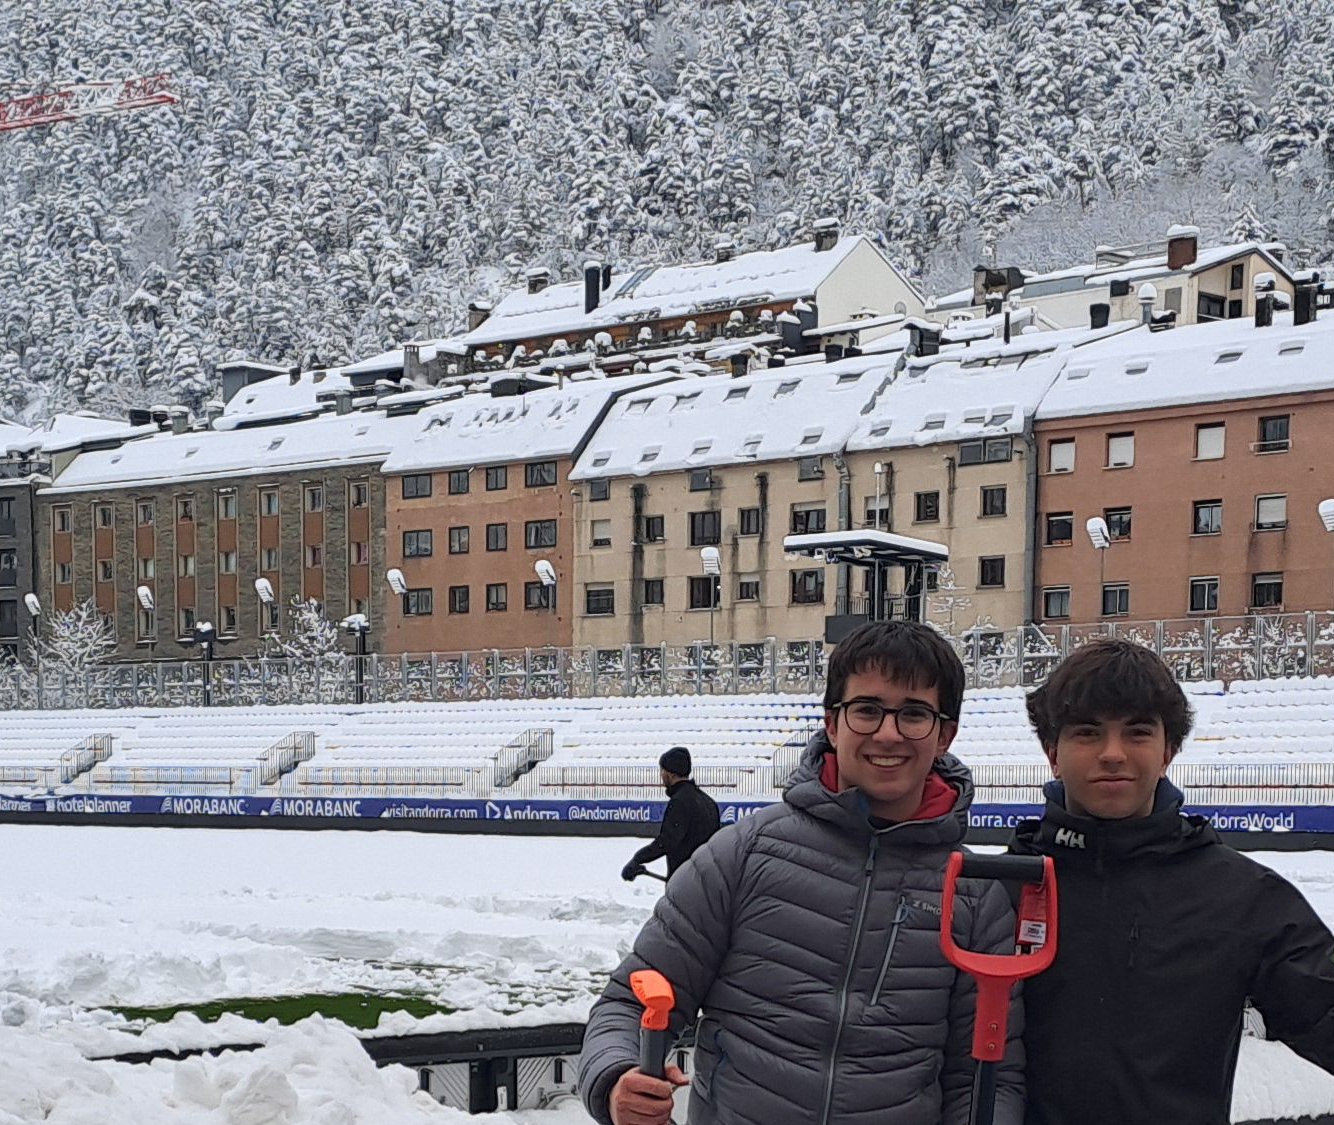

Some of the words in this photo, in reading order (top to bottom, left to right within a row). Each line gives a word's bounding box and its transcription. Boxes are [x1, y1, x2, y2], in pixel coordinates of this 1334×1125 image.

[57, 796, 131, 813] hotelplanner
[173, 798, 246, 815] MORABANC
[283, 799, 362, 817] MORABANC
[386, 802, 478, 819] visitandorra.com
[504, 804, 560, 820] Andorra
[568, 805, 651, 821] @AndorraWorld
[1179, 811, 1295, 830] dorraWorld
[1054, 827, 1087, 849] HH
